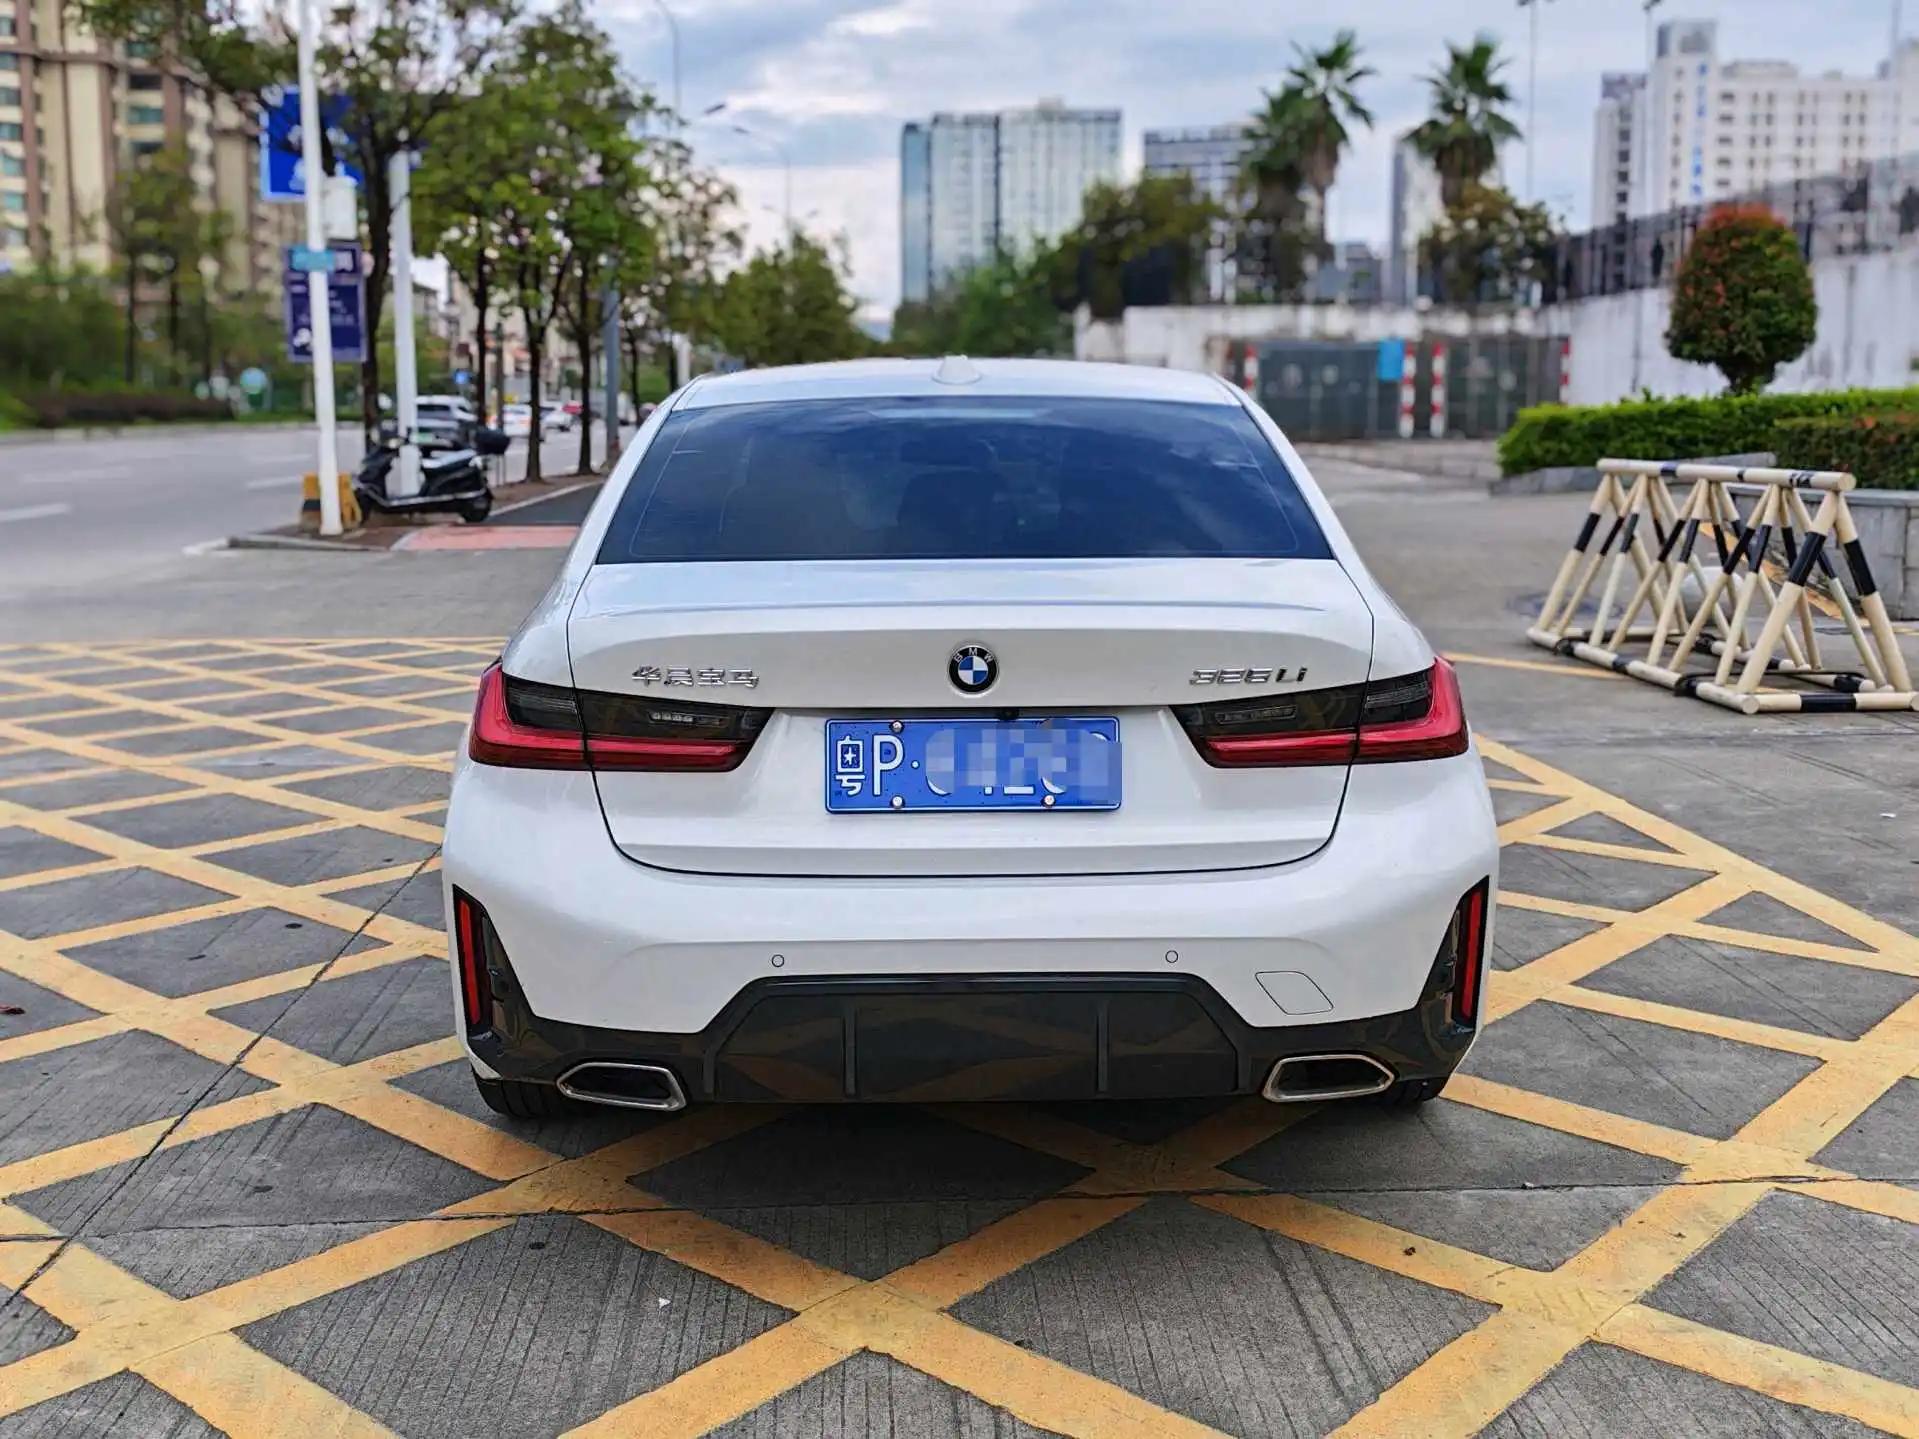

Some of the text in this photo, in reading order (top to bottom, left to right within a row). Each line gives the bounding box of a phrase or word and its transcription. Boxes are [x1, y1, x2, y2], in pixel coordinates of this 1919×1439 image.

[953, 647, 994, 664] BMW
[631, 665, 760, 688] 华晨宝马
